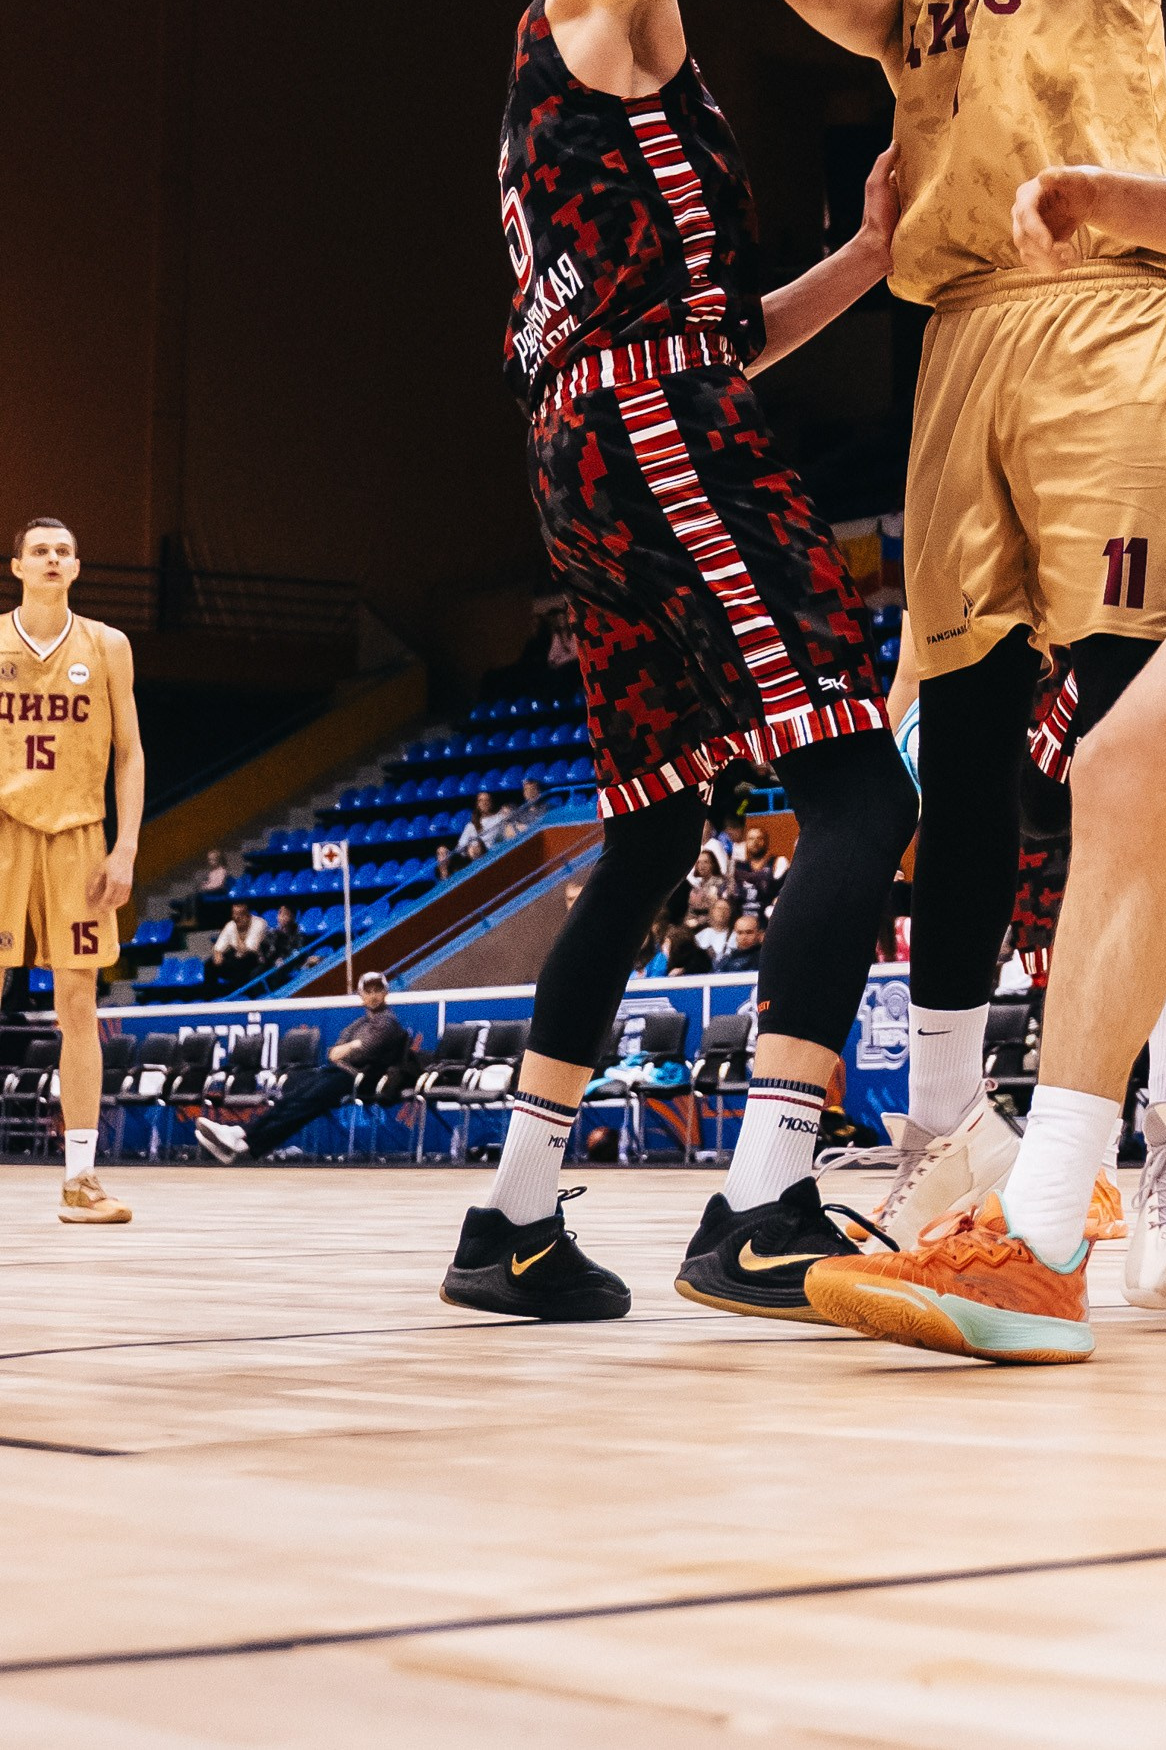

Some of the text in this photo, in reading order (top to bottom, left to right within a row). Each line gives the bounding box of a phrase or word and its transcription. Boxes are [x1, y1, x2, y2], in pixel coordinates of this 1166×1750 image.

[1102, 536, 1148, 610] 11
[0, 691, 91, 724] ЦИВС
[25, 734, 56, 770] 15
[70, 919, 99, 956] 15
